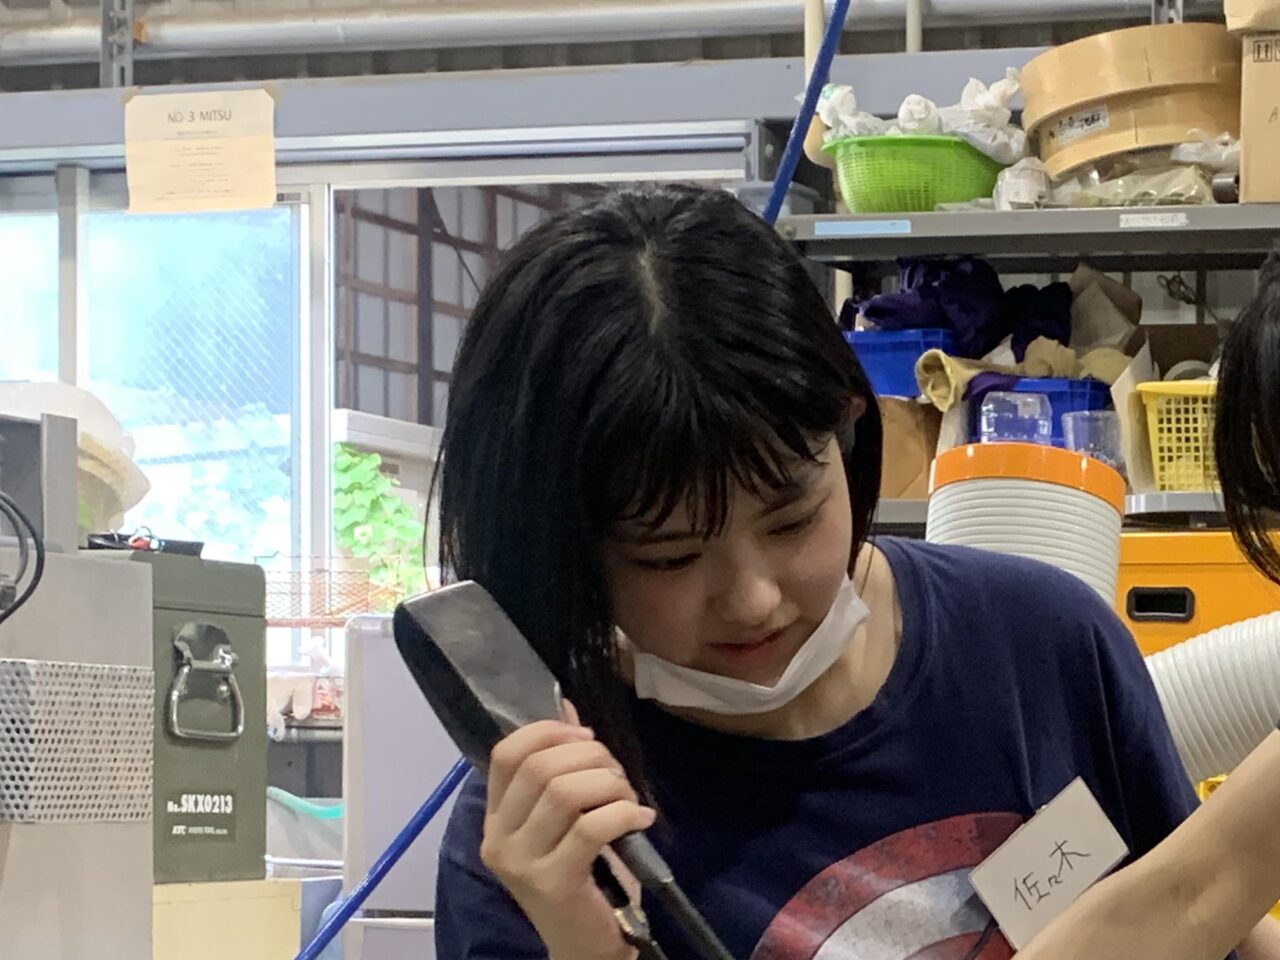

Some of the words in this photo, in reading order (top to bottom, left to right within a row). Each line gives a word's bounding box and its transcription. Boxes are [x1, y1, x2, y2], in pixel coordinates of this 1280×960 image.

[167, 111, 183, 123] NO
[187, 110, 195, 122] 3
[199, 108, 232, 121] MITSU
[1014, 839, 1091, 911] 佐々木
